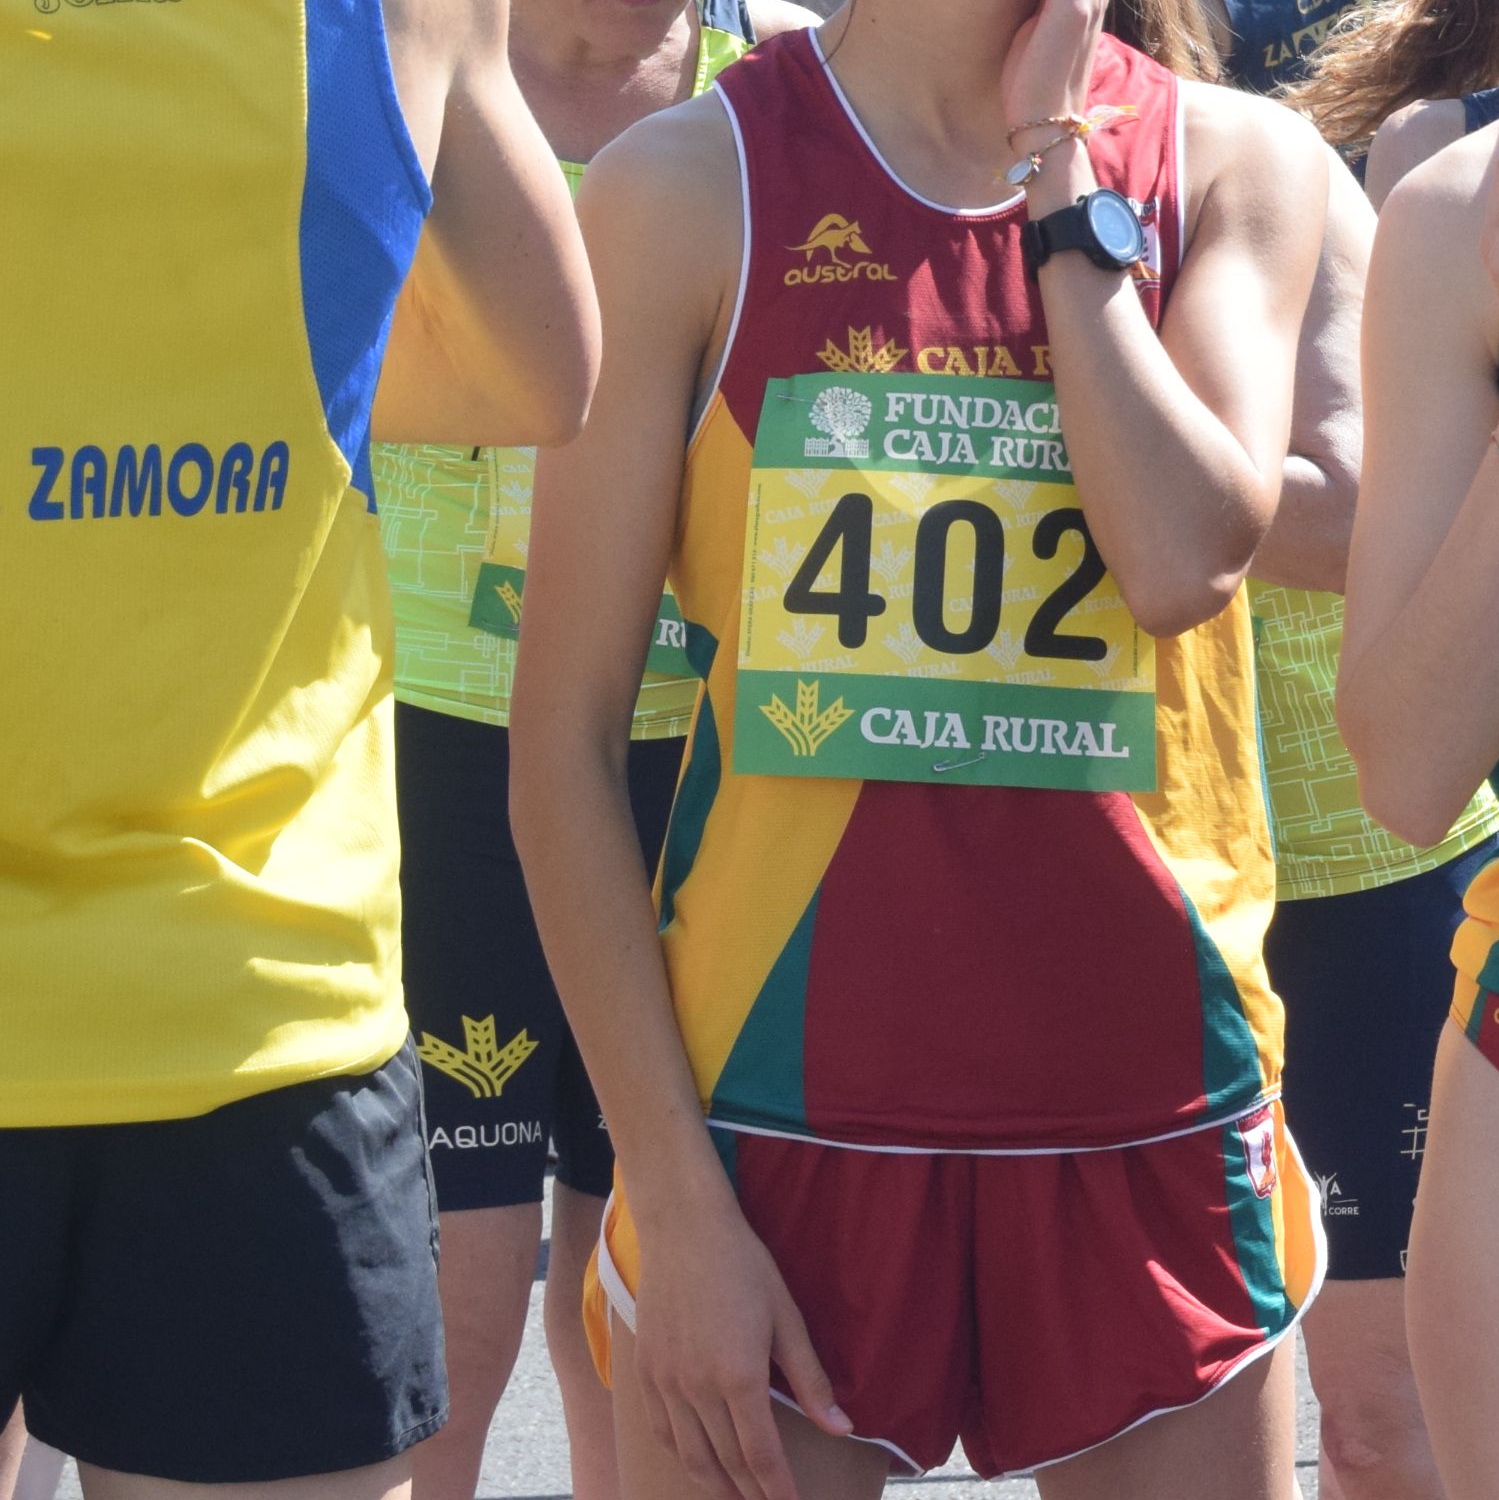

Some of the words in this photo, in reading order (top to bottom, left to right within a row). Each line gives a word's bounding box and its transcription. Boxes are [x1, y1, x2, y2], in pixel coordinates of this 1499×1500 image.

[916, 346, 1023, 376] CAJA
[885, 392, 1060, 434] FUNDACI
[883, 429, 979, 466] CAJA
[28, 440, 290, 521] ZAMORA
[783, 493, 1109, 662] 402
[860, 708, 973, 751] CAJA
[981, 715, 1129, 759] RURAL
[429, 1120, 542, 1150] AQUONA
[1328, 1206, 1360, 1216] CORRE
